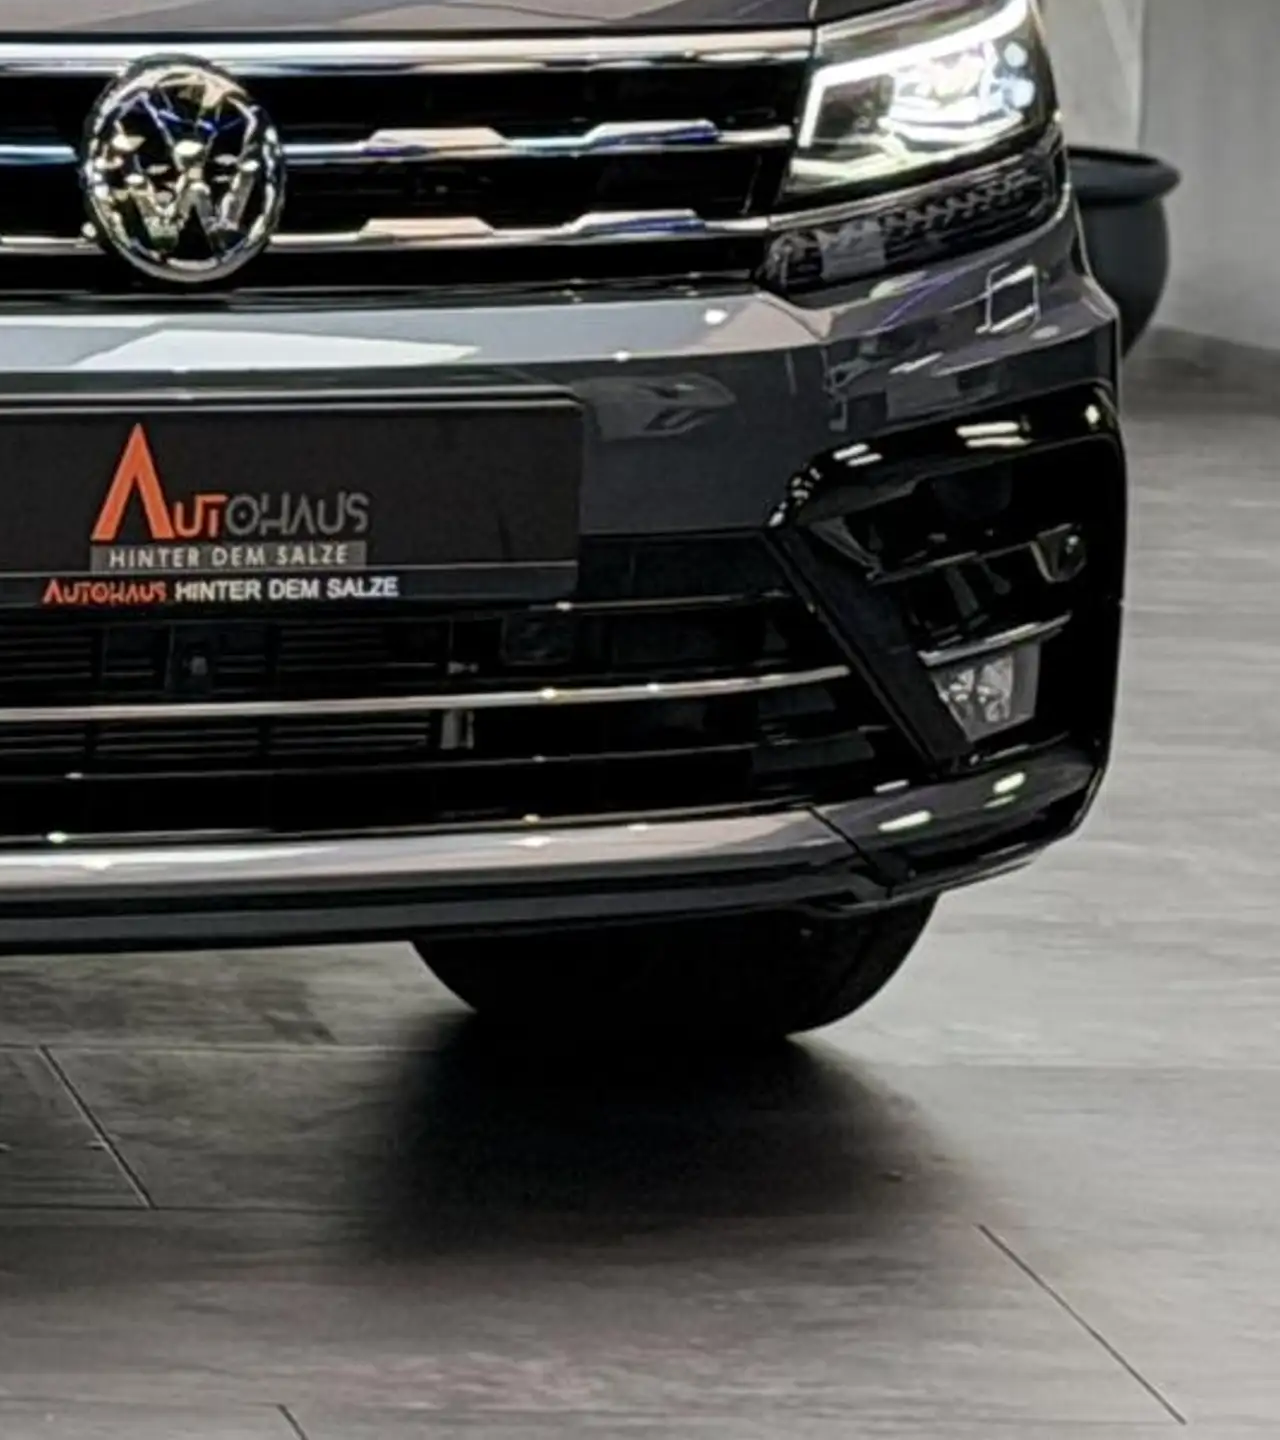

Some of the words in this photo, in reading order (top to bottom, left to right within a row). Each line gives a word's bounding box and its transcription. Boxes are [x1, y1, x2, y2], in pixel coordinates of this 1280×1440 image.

[109, 548, 200, 568] HINTER
[211, 546, 266, 567] DEM
[277, 543, 349, 565] SALZE
[43, 578, 167, 604] AUTOHAUS
[175, 580, 262, 602] HINTER
[268, 578, 319, 600] DEM
[327, 576, 400, 598] SALZE
